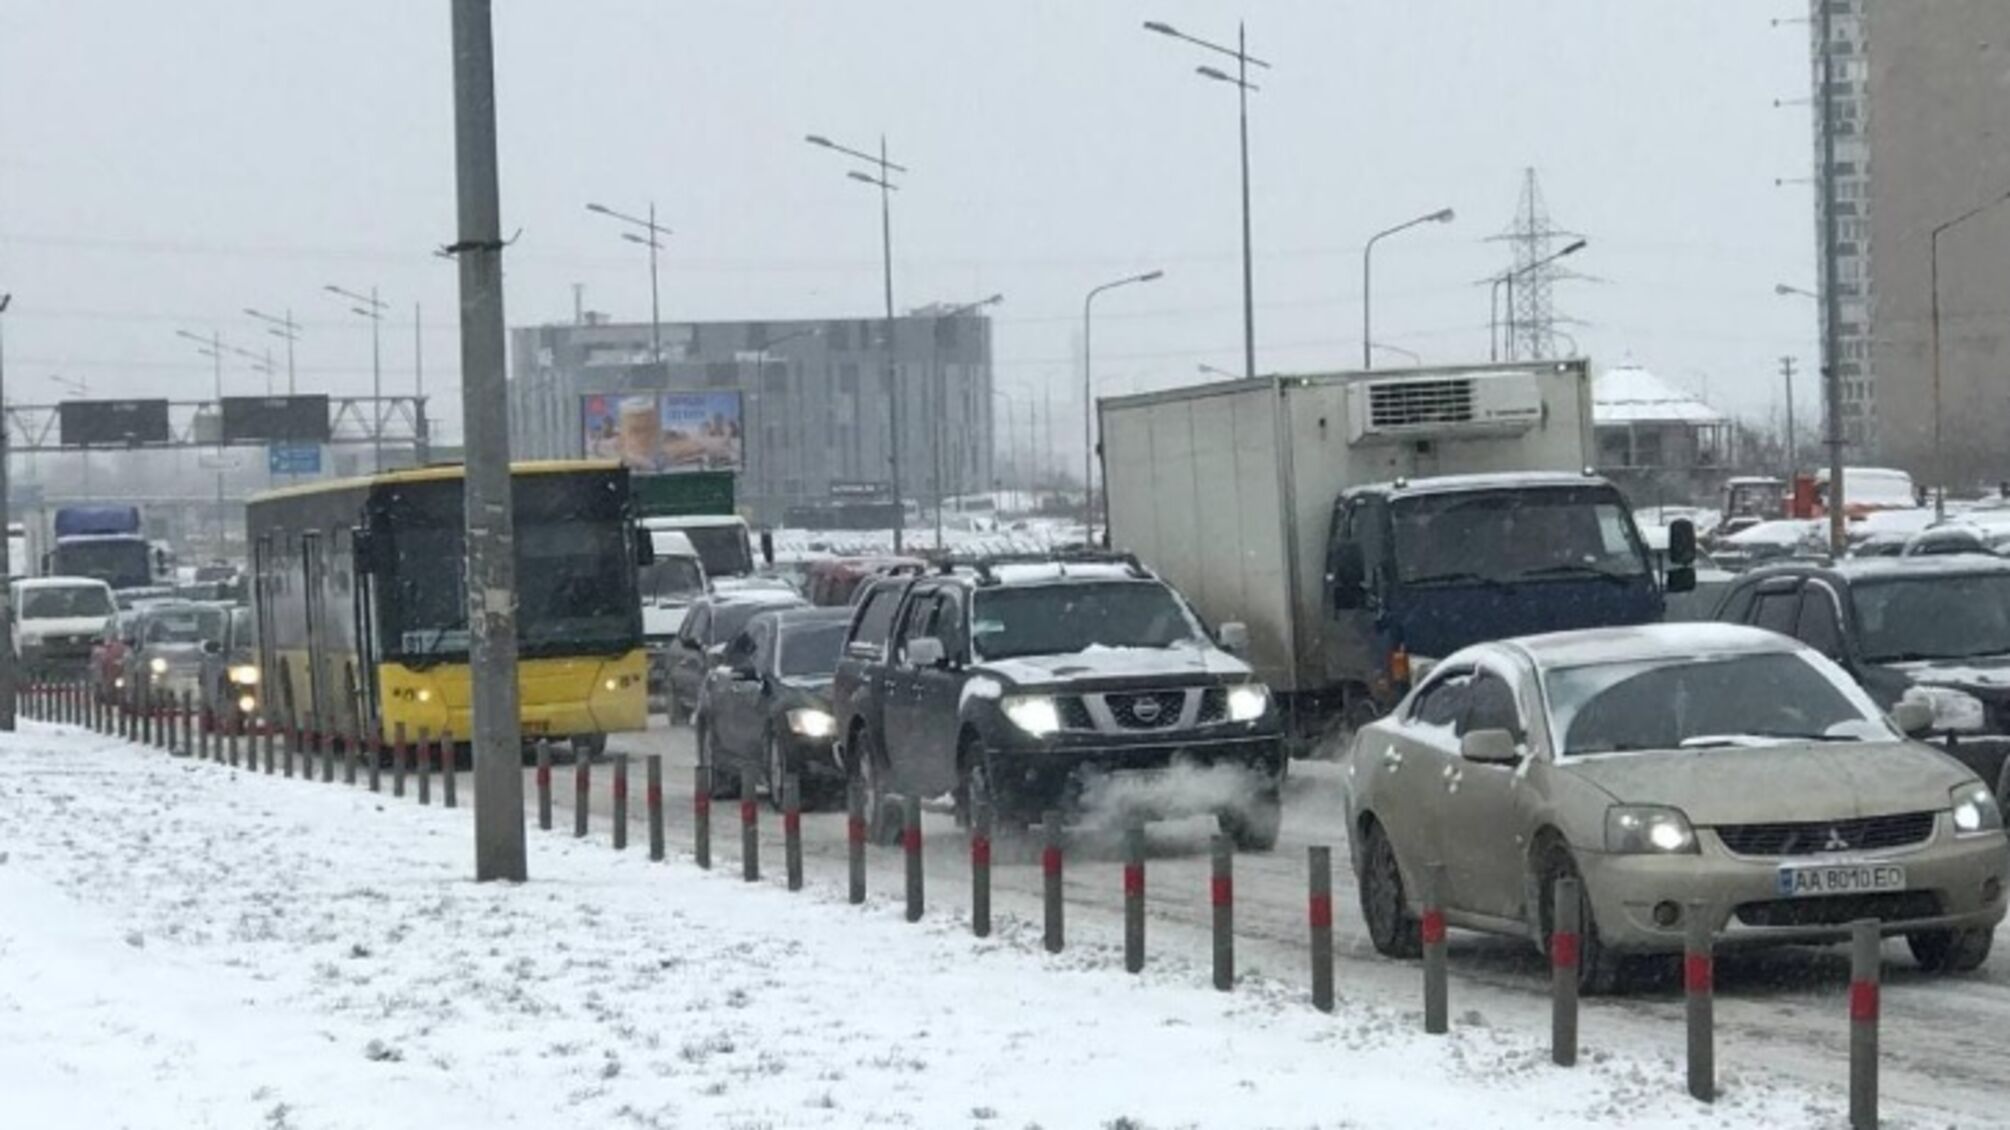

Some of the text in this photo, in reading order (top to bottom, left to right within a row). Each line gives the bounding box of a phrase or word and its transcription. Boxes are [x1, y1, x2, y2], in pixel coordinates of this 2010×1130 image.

[1794, 867, 1902, 891] AA 8010 EO
